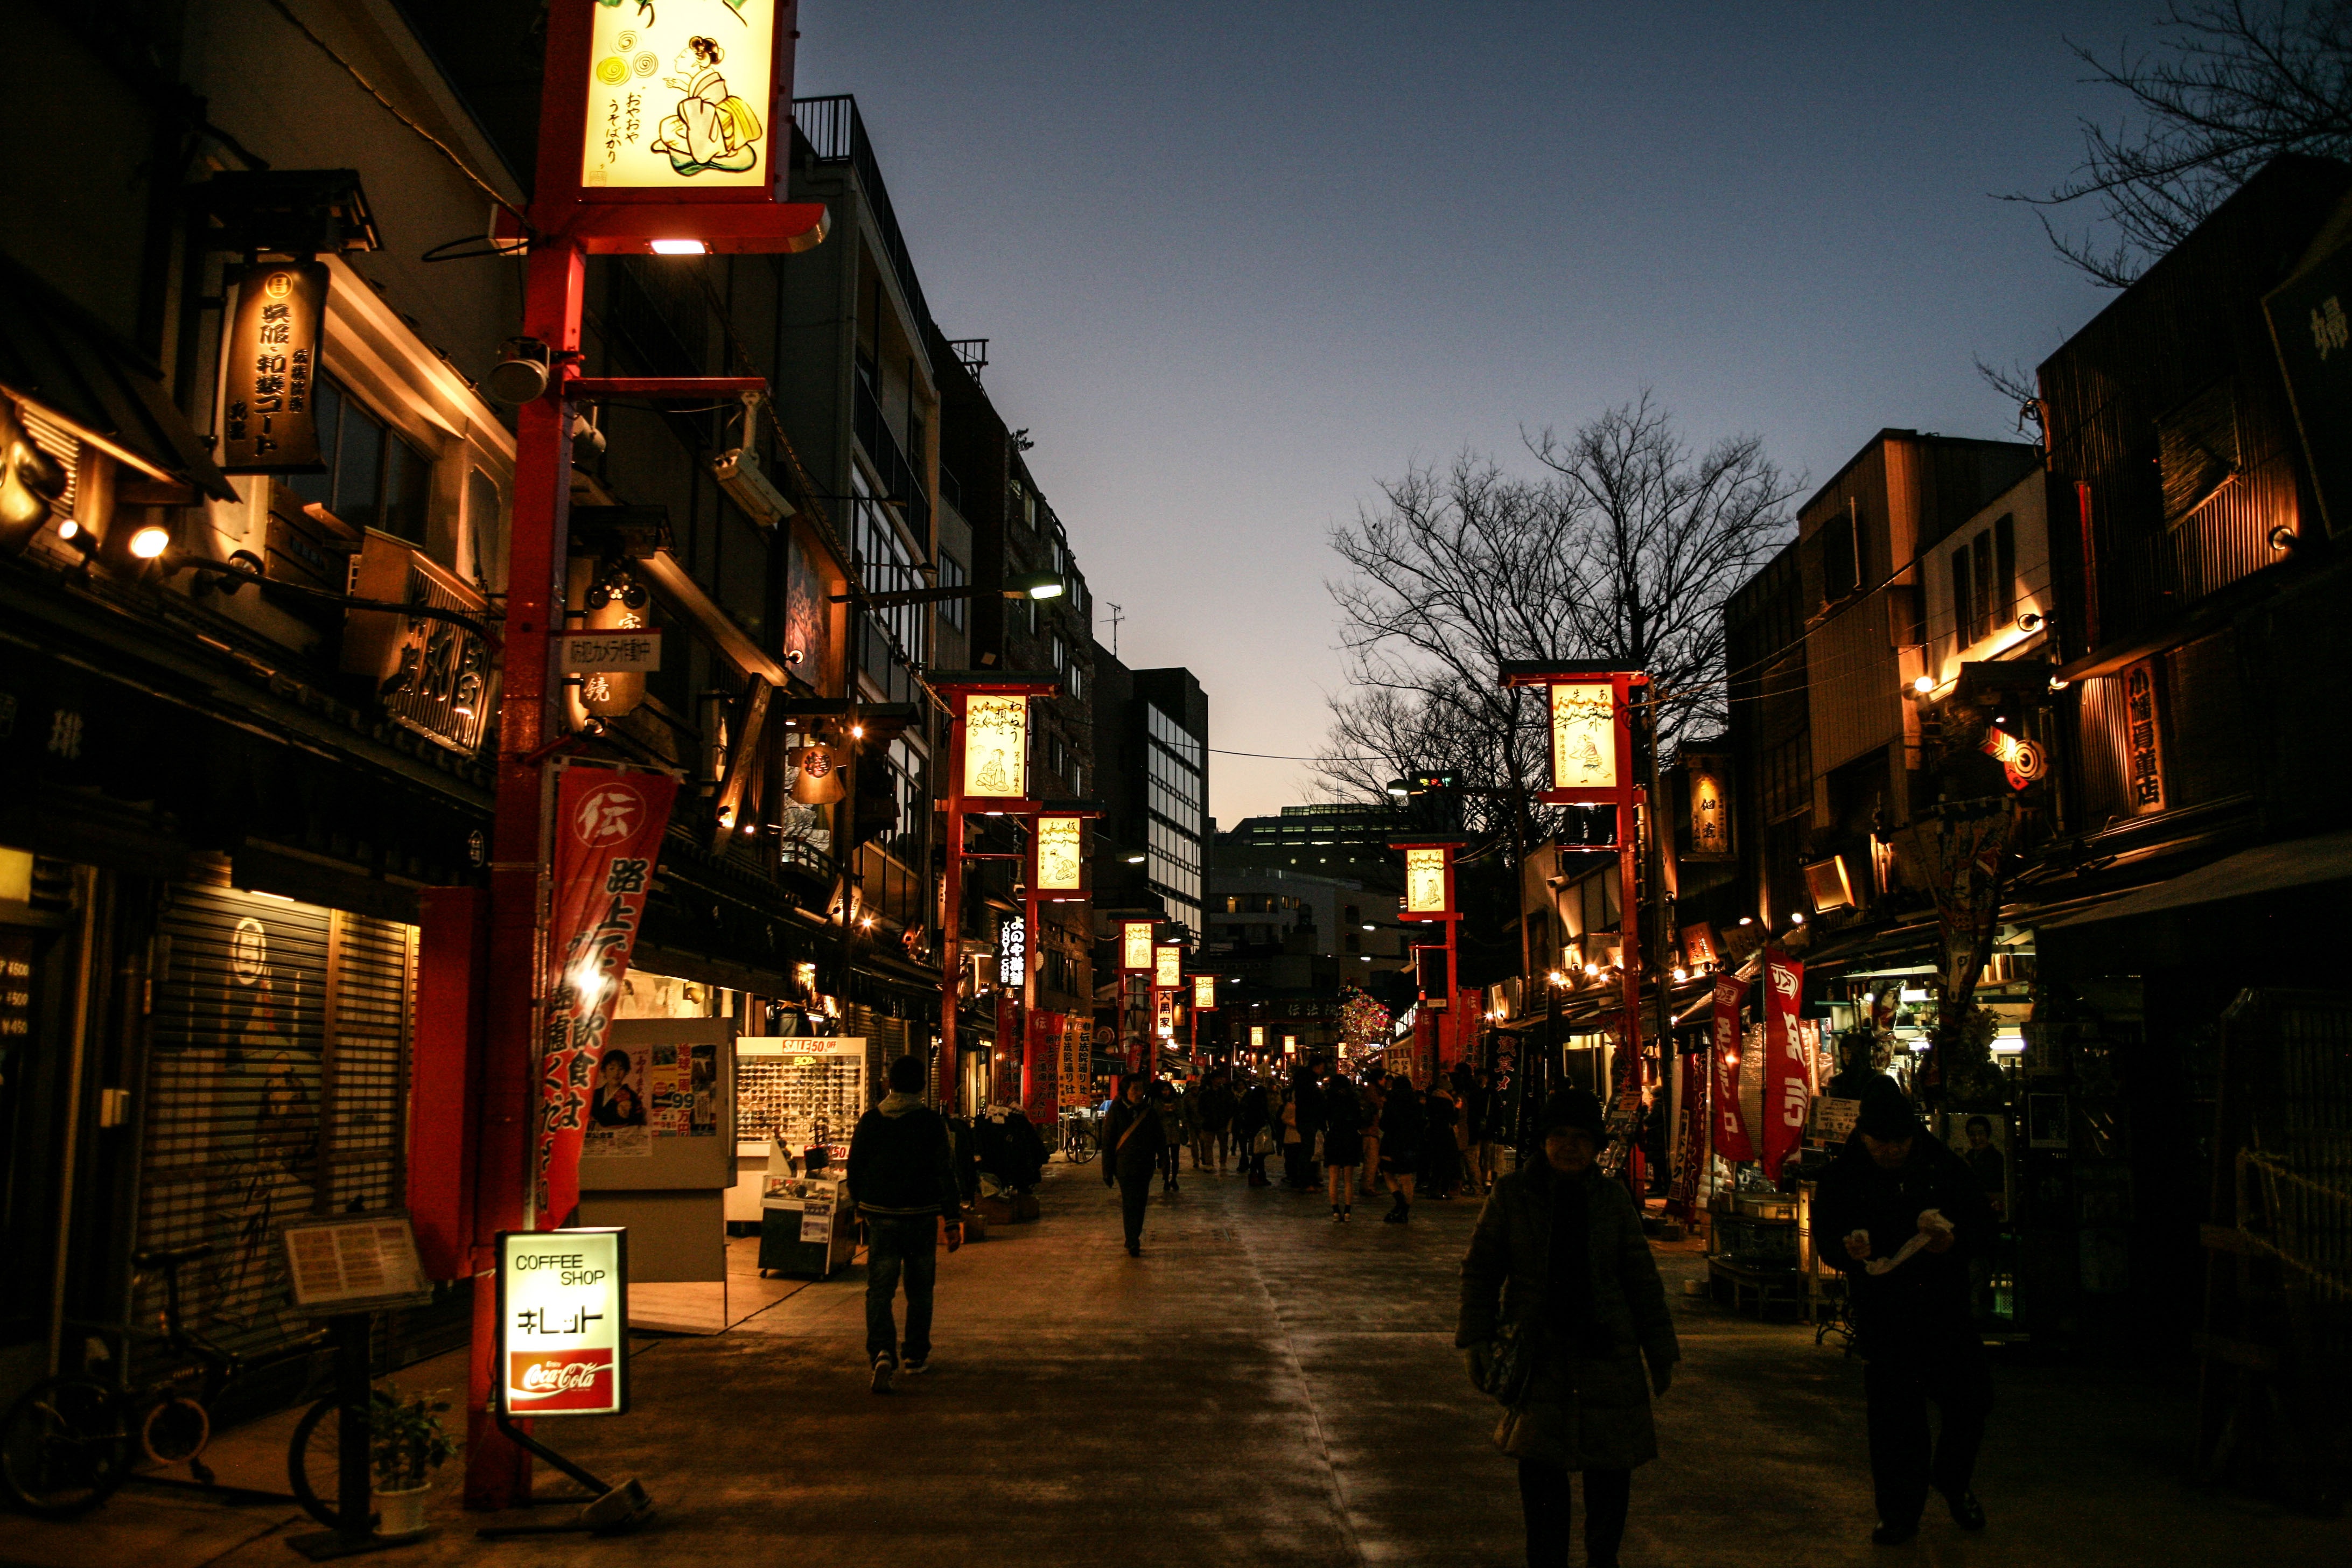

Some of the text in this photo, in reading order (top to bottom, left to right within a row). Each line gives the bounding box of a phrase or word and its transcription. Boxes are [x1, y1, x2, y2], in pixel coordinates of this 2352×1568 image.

[605, 99, 621, 164] うそばかり
[625, 92, 641, 144] おやおや
[1000, 921, 1010, 983] YONOYA COMB
[783, 1040, 811, 1053] SALE
[516, 1254, 583, 1270] COFFEE
[561, 1270, 605, 1286] SHOP
[523, 1362, 597, 1390] Coca-Cola
